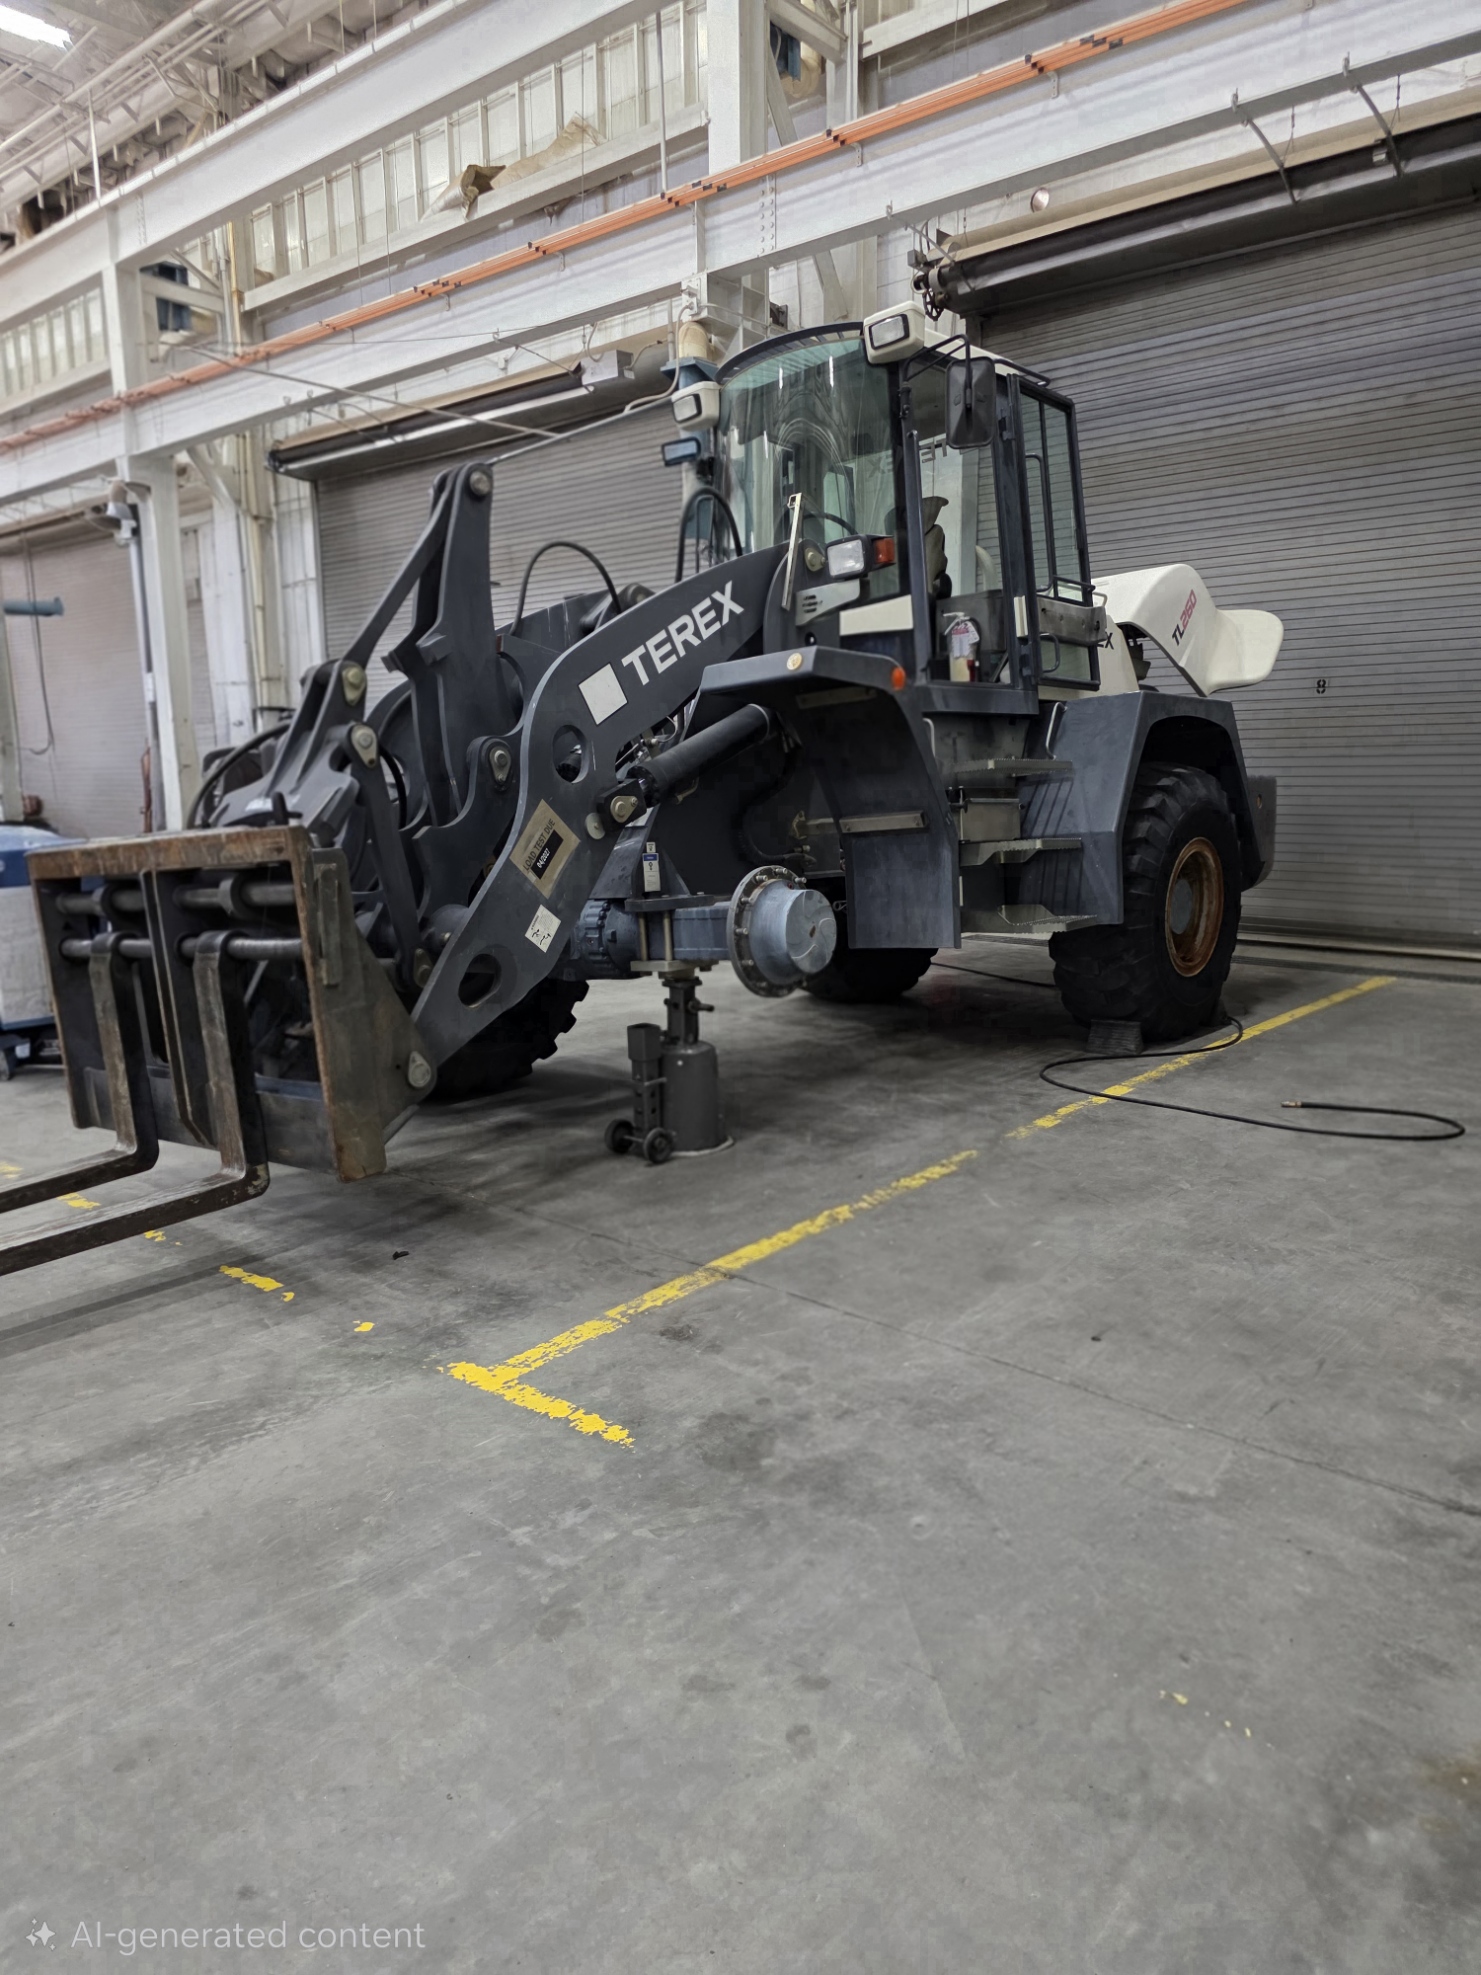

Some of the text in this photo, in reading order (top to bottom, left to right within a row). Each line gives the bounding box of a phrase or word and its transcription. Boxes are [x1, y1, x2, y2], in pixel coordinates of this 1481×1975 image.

[621, 580, 744, 686] TEREX
[1172, 589, 1197, 646] TL260
[1316, 679, 1326, 694] 8
[523, 818, 555, 871] LOAD TEST DUE
